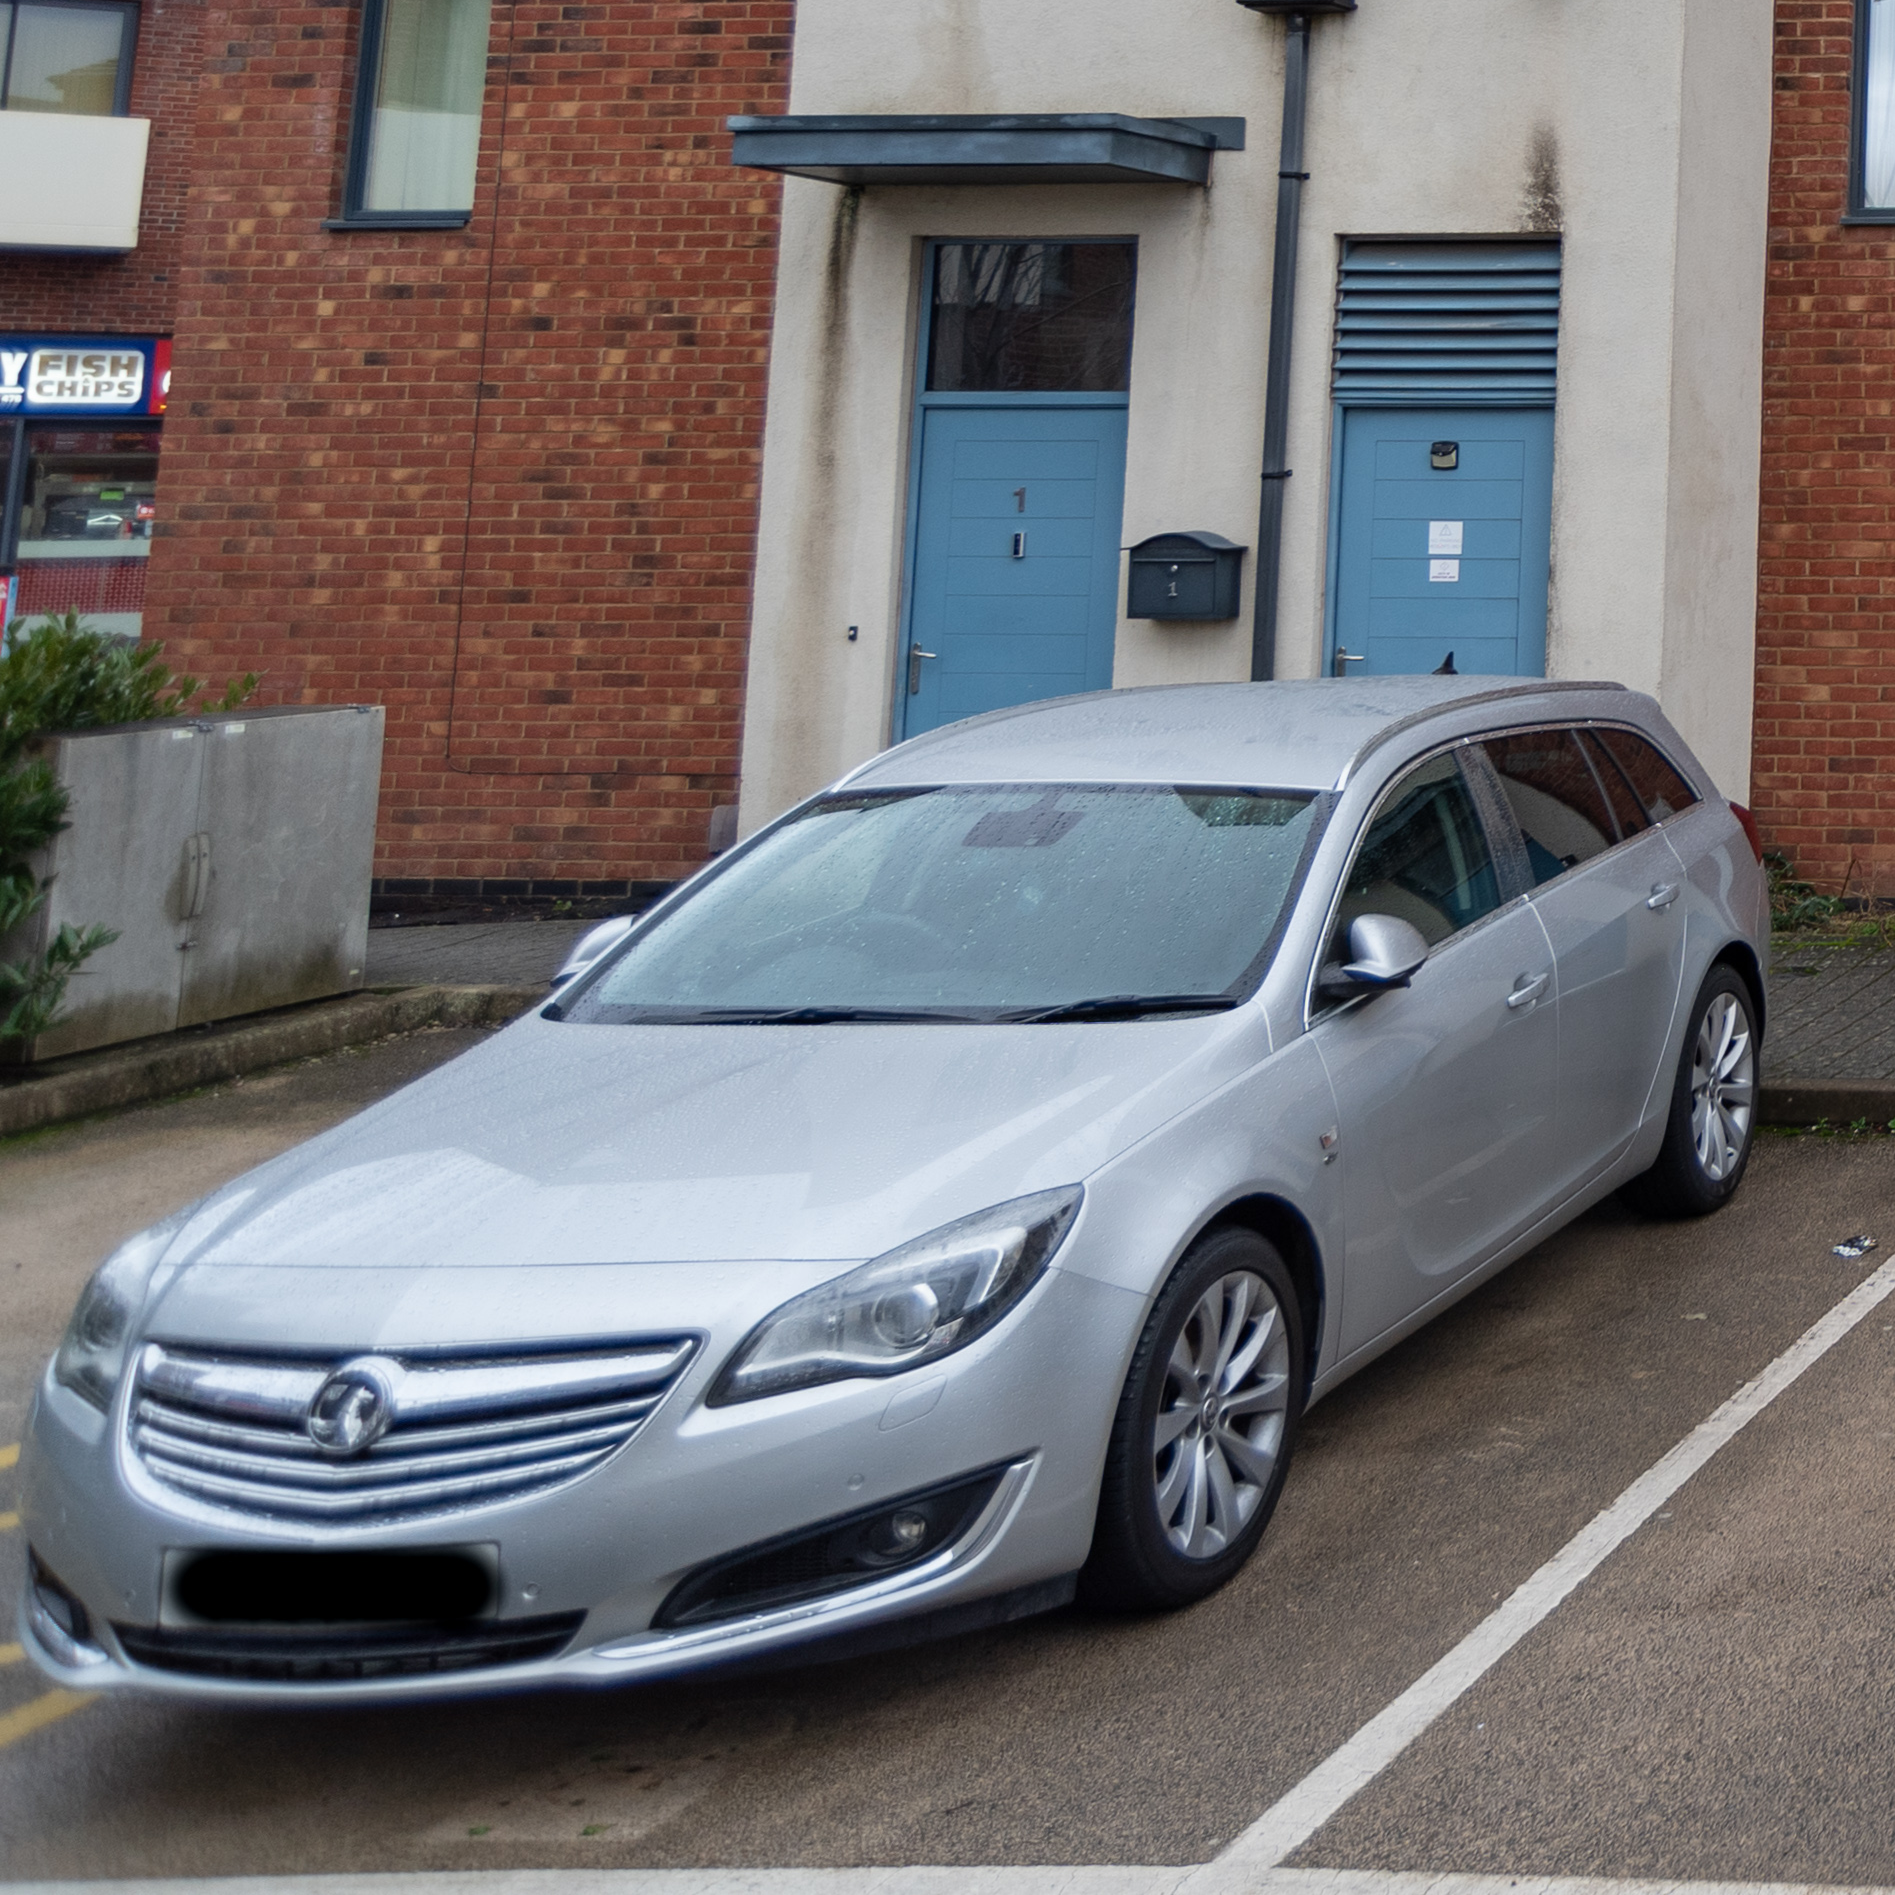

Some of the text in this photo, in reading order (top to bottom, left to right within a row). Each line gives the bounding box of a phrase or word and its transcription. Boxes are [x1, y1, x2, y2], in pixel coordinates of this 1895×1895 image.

[37, 354, 139, 377] FISH
[1013, 487, 1026, 513] 1
[1168, 581, 1178, 597] 1
